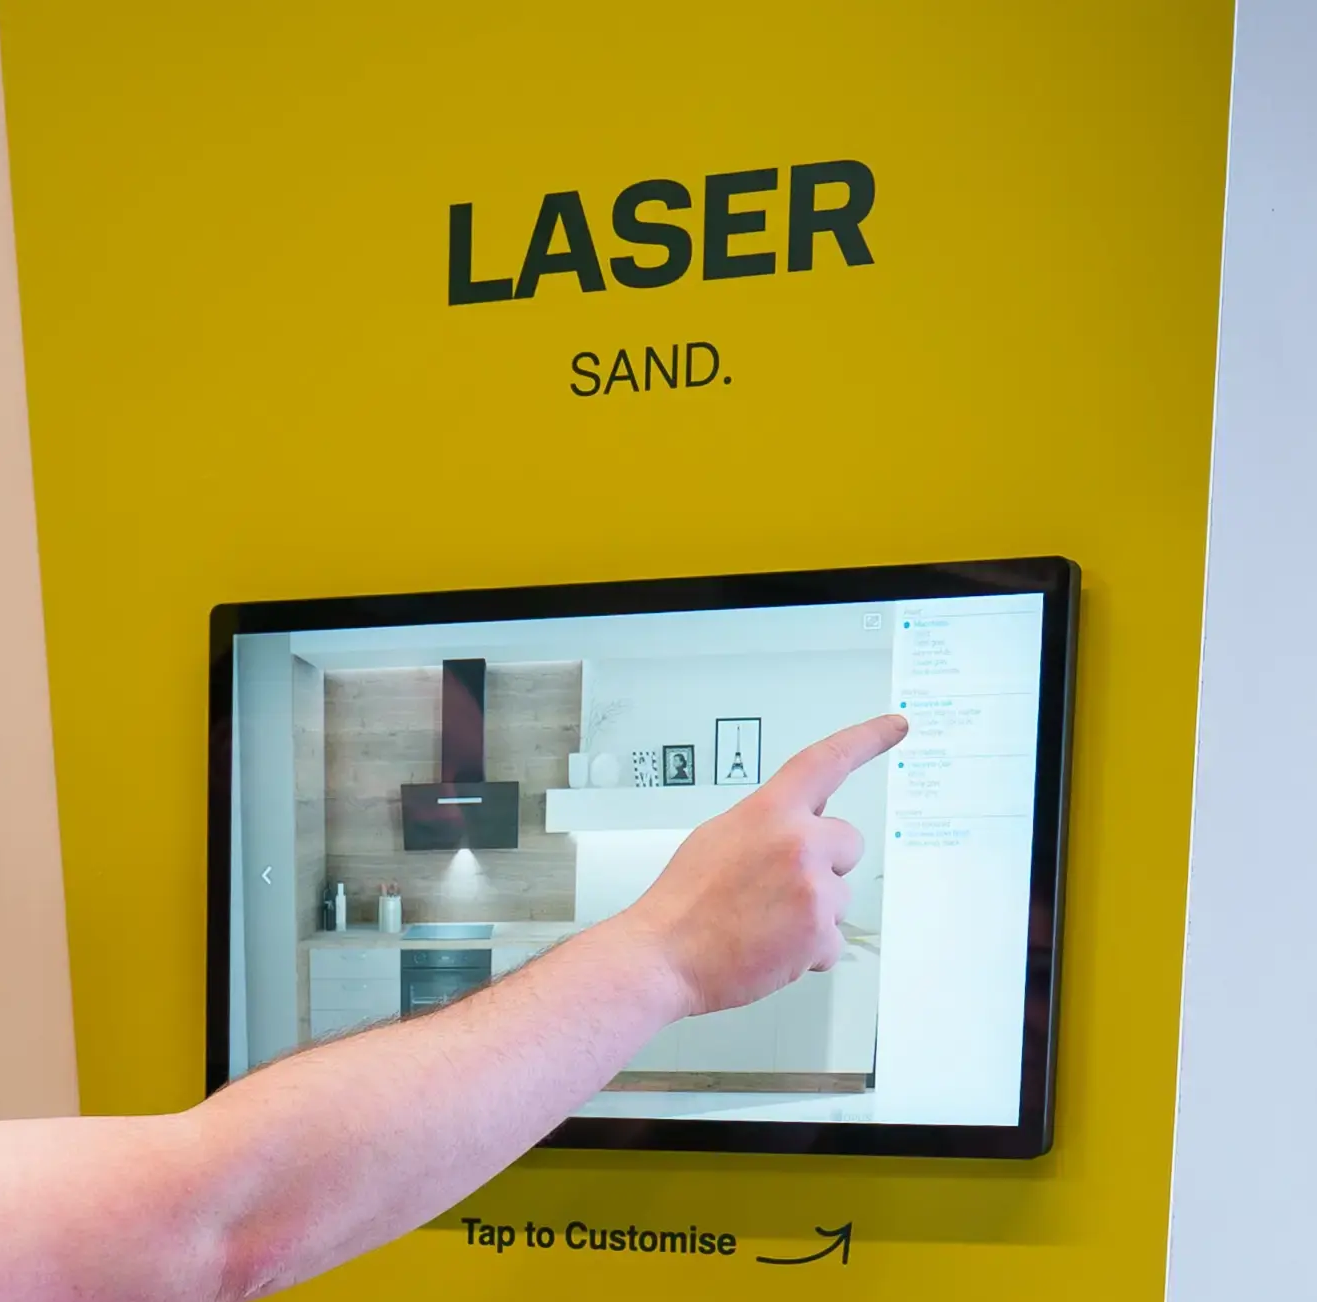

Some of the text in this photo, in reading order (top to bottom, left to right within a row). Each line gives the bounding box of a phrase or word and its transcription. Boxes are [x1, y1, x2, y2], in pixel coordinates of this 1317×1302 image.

[447, 159, 876, 307] LASER
[570, 341, 732, 397] SAND.
[461, 1217, 736, 1255] Tap to Customise
